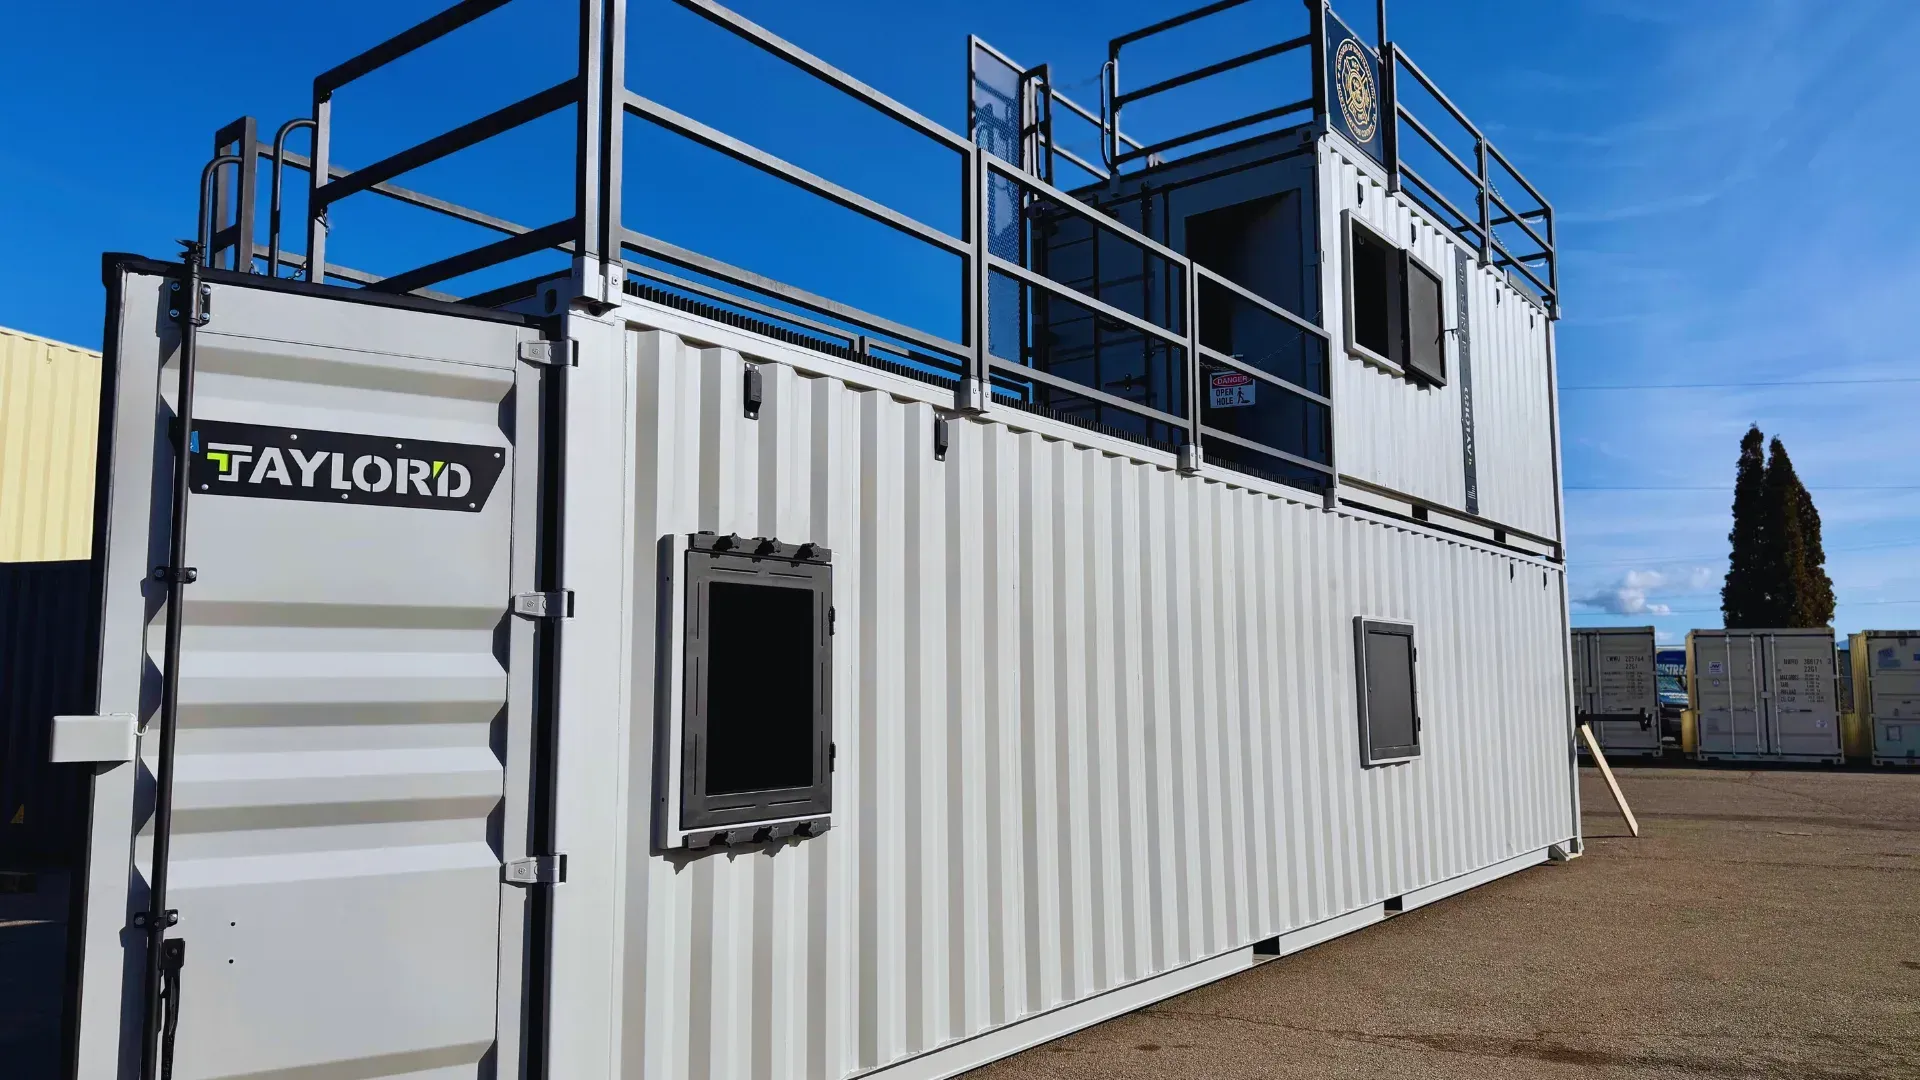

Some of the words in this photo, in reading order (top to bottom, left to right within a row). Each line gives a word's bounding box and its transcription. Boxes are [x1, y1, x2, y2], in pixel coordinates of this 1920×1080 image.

[1217, 375, 1248, 385] DANGER
[1215, 387, 1234, 397] OPEN
[1216, 397, 1234, 406] HOLE
